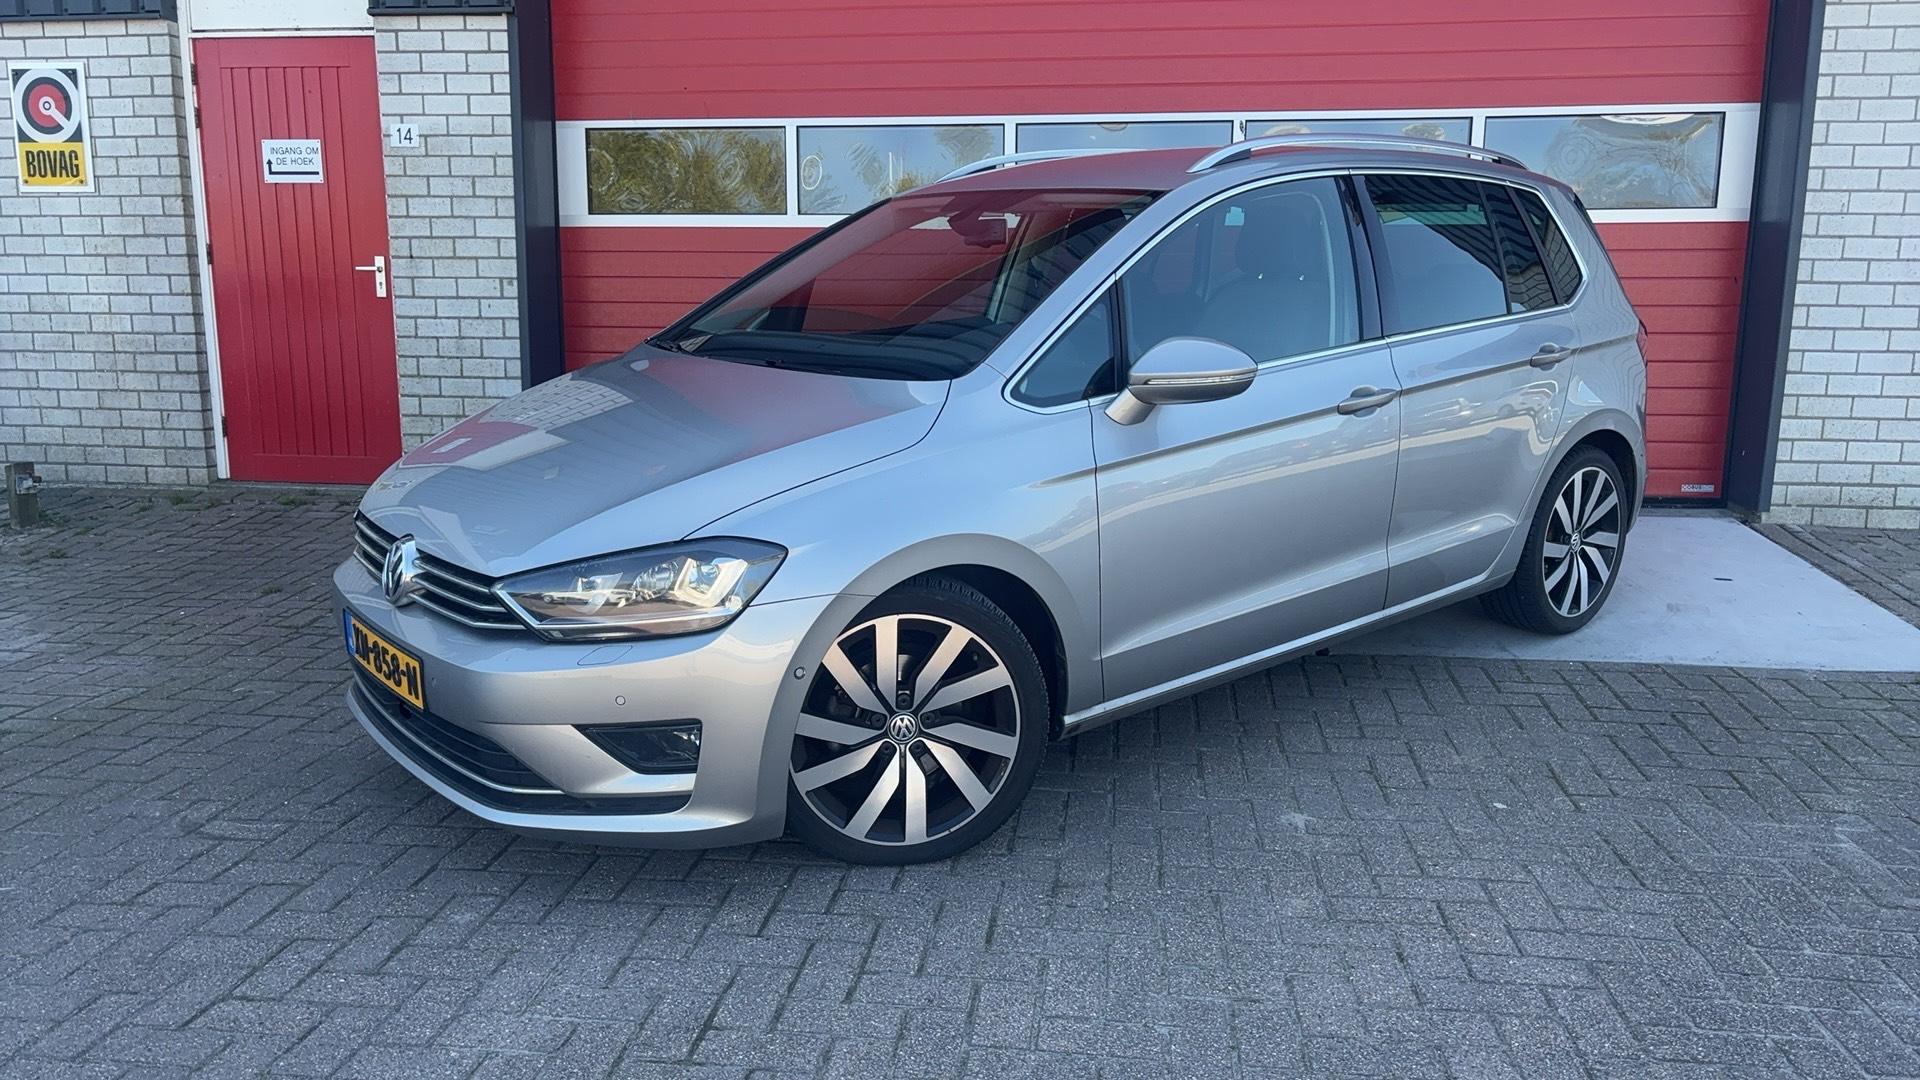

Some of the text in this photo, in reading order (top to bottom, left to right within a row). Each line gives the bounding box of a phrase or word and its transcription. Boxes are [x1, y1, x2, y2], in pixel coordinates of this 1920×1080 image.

[396, 127, 414, 145] 14
[270, 146, 320, 155] INGANG OM
[25, 150, 80, 178] BOVAG
[275, 157, 315, 166] DE HOEK
